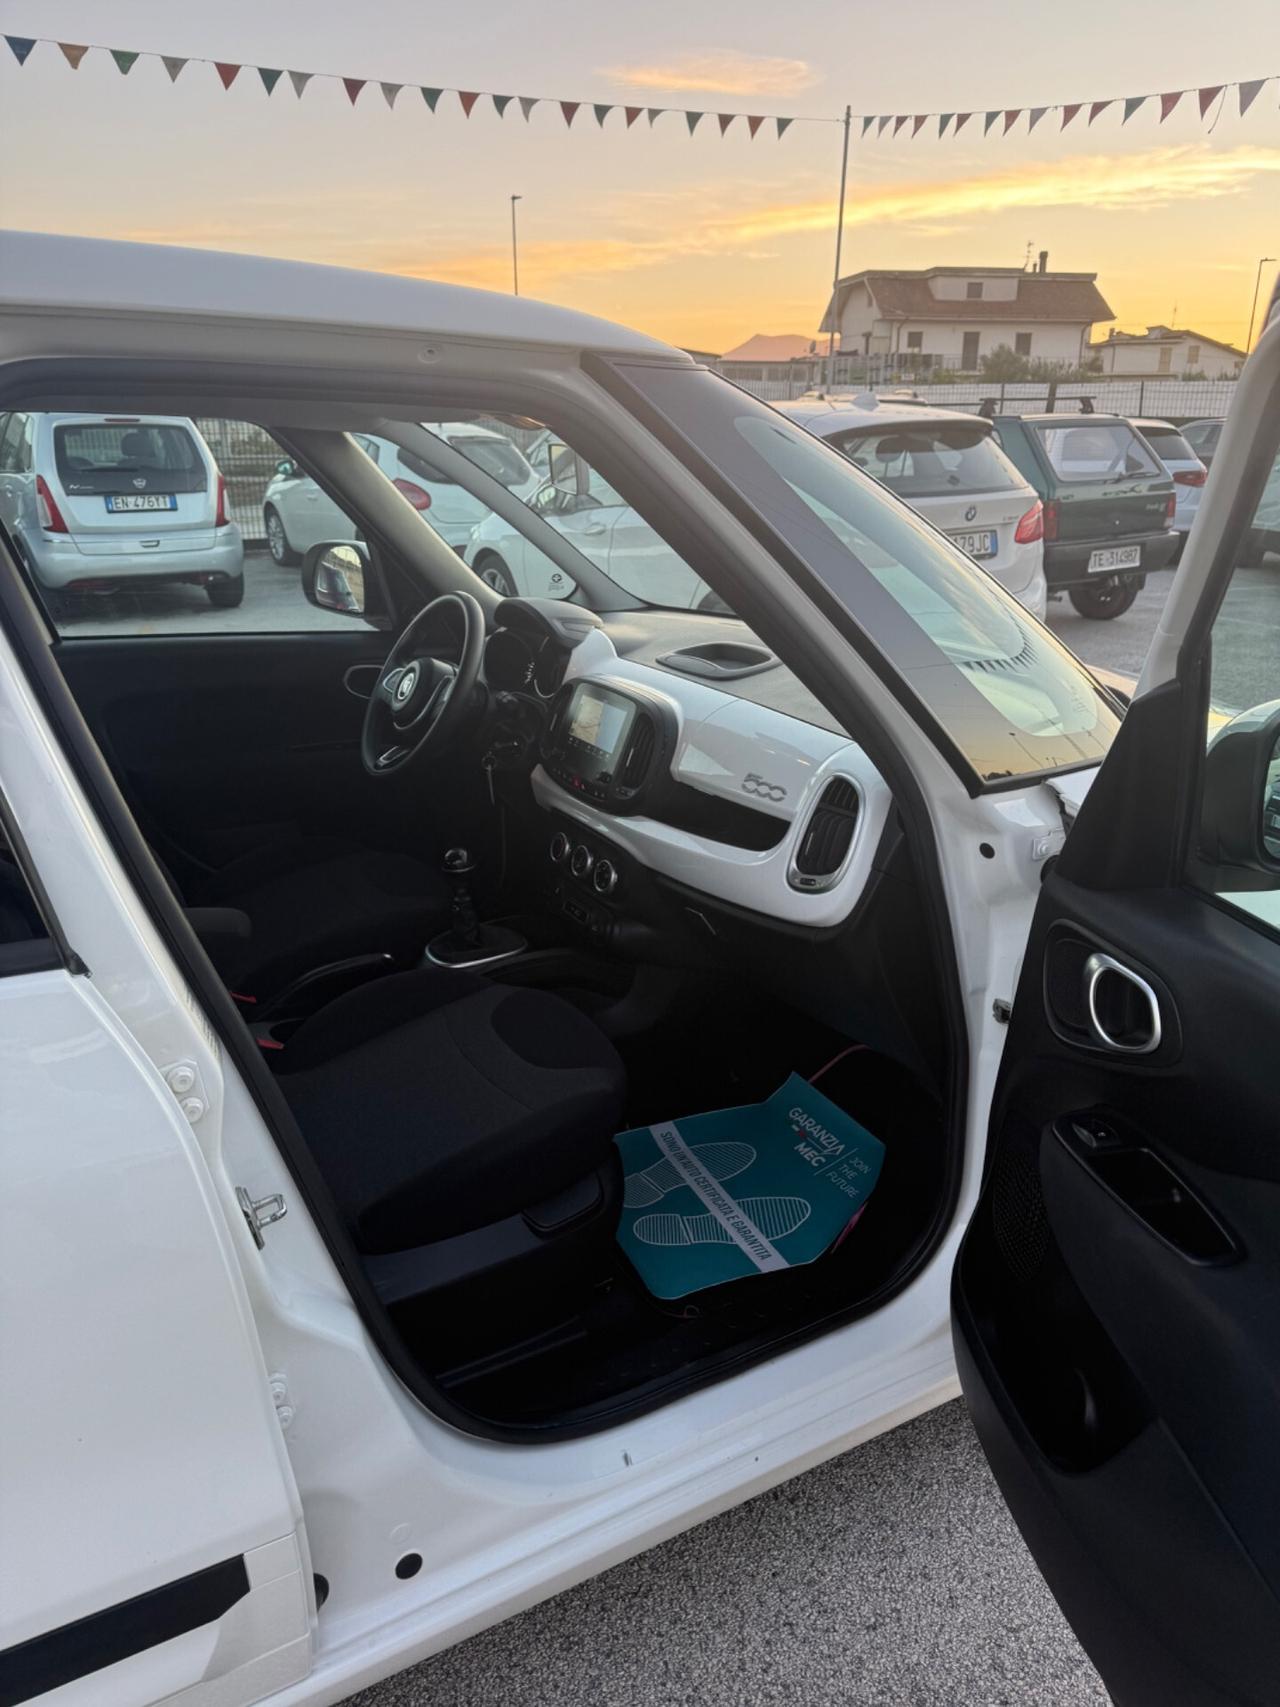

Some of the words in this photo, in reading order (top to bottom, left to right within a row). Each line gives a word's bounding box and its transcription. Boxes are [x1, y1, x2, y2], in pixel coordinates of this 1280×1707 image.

[114, 496, 128, 509] EN
[742, 773, 787, 802] 500
[788, 1107, 845, 1156] GARANZIA
[793, 1142, 826, 1167] MEC
[849, 1157, 871, 1174] JOIN
[838, 1164, 858, 1180] THE
[660, 1131, 681, 1154] SONO
[694, 1176, 734, 1216] CERTIFICATA
[731, 1219, 772, 1260] GARANTITA
[825, 1172, 860, 1199] FUTURE
